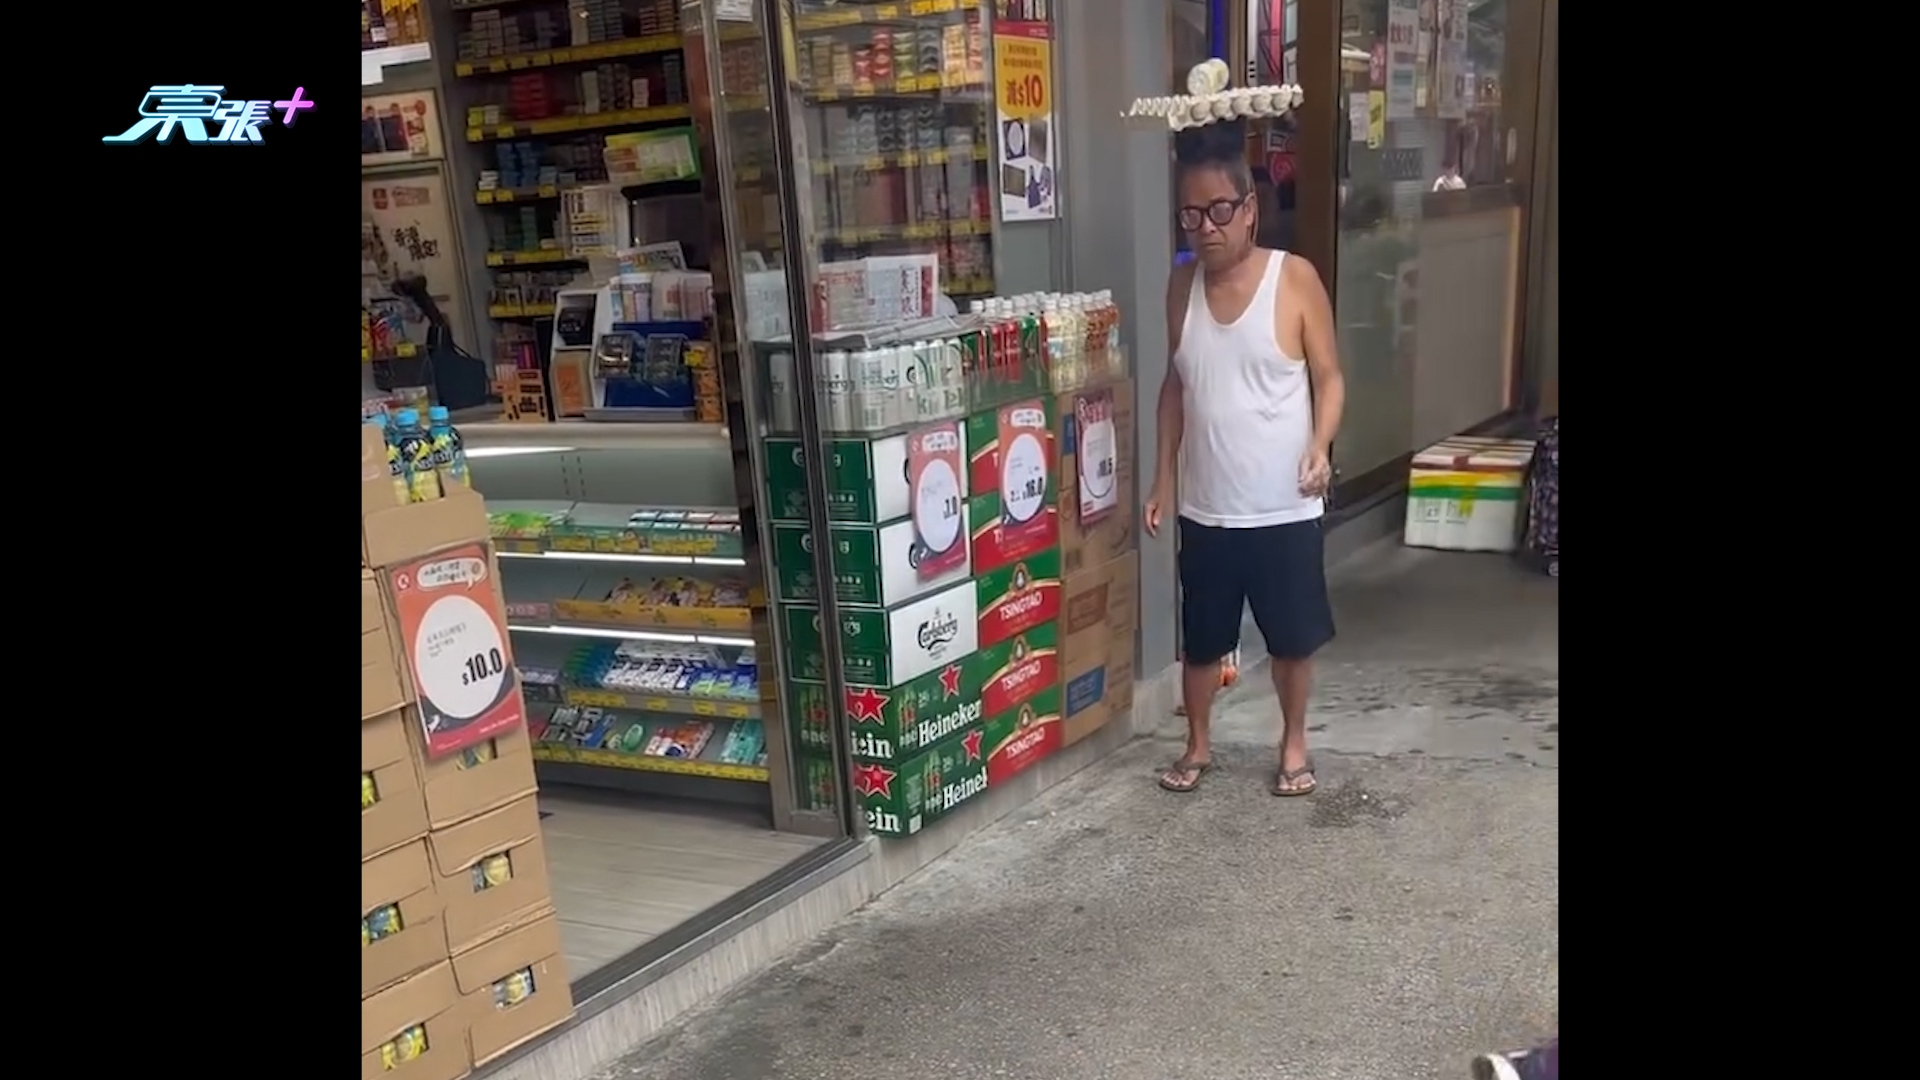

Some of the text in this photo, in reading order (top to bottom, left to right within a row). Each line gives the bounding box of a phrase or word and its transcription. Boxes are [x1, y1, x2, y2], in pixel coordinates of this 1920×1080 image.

[1000, 591, 1043, 621] TSINGTAO
[462, 647, 504, 686] $10.0
[1001, 659, 1042, 691] TSINGTAO
[1005, 726, 1046, 760] TSINGTAO
